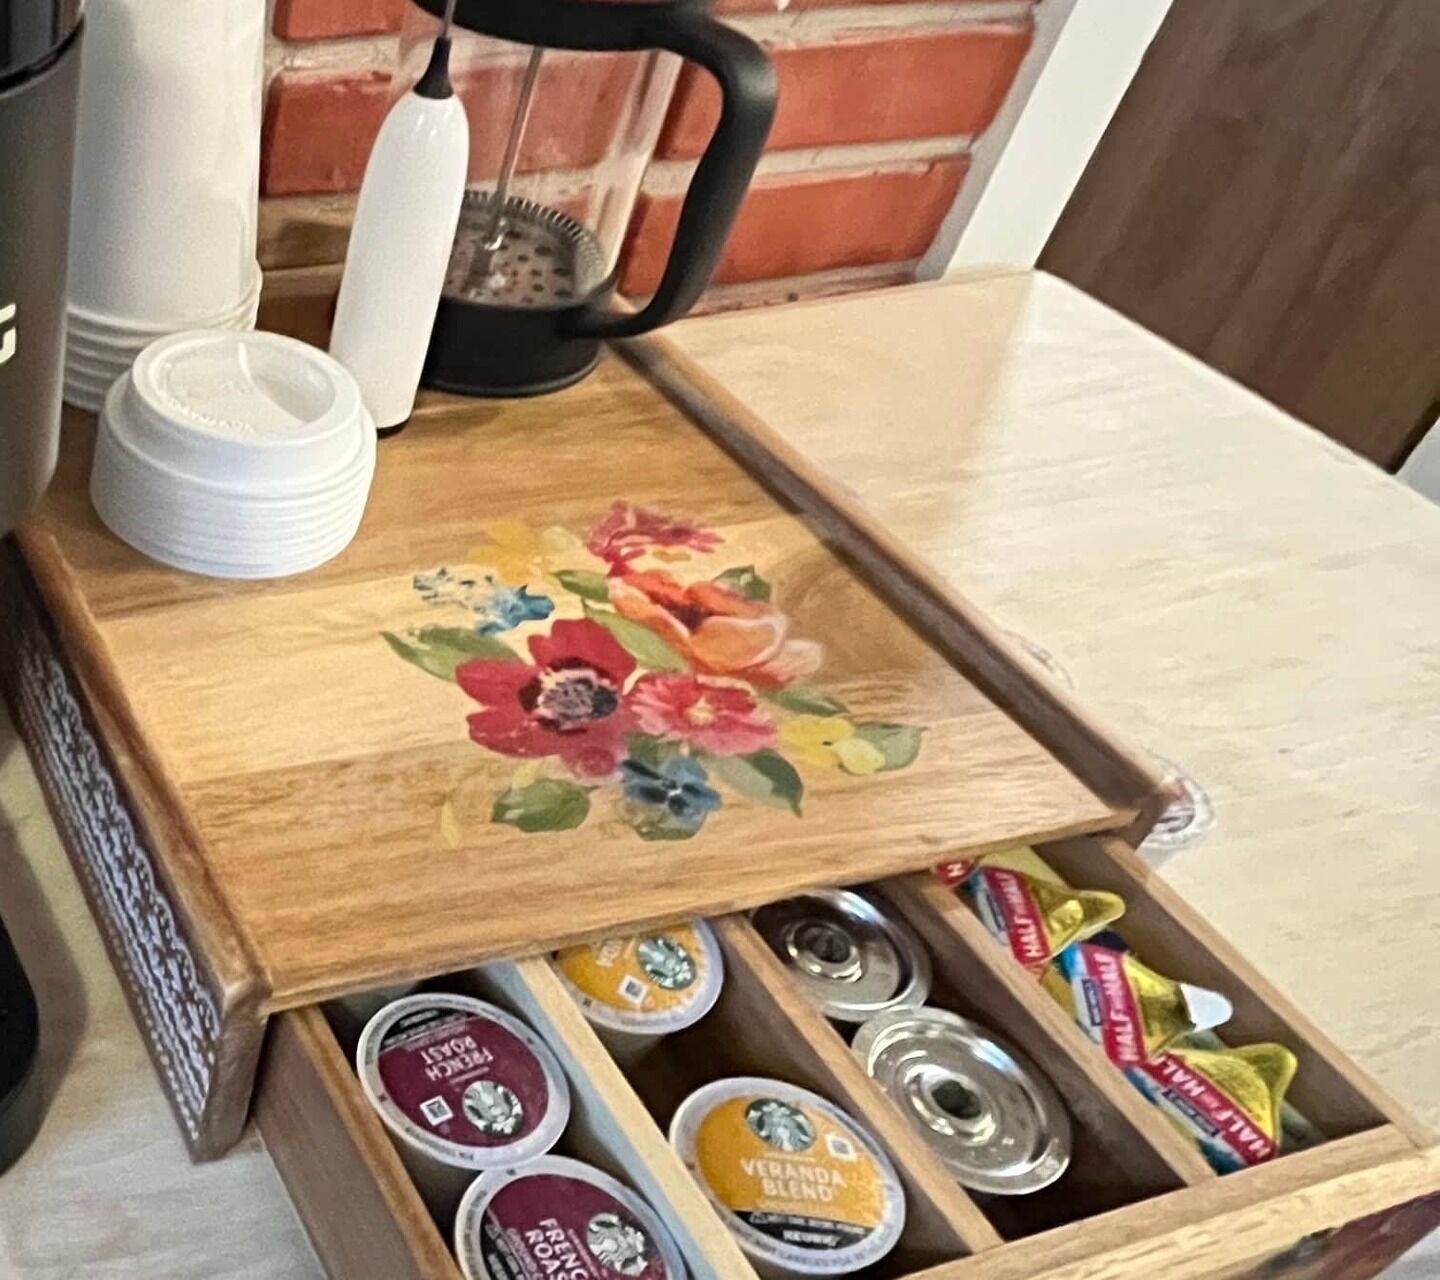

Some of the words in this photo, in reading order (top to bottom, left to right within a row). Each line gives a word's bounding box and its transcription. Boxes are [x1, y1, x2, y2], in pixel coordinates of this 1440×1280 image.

[1013, 914, 1046, 957] HALF
[420, 1035, 478, 1065] ROAST
[1110, 1009, 1141, 1061] HALF
[424, 1047, 494, 1081] FRENCH
[1213, 1110, 1271, 1158] HALF
[739, 1157, 849, 1189] VERANDA
[761, 1177, 833, 1203] BLEND
